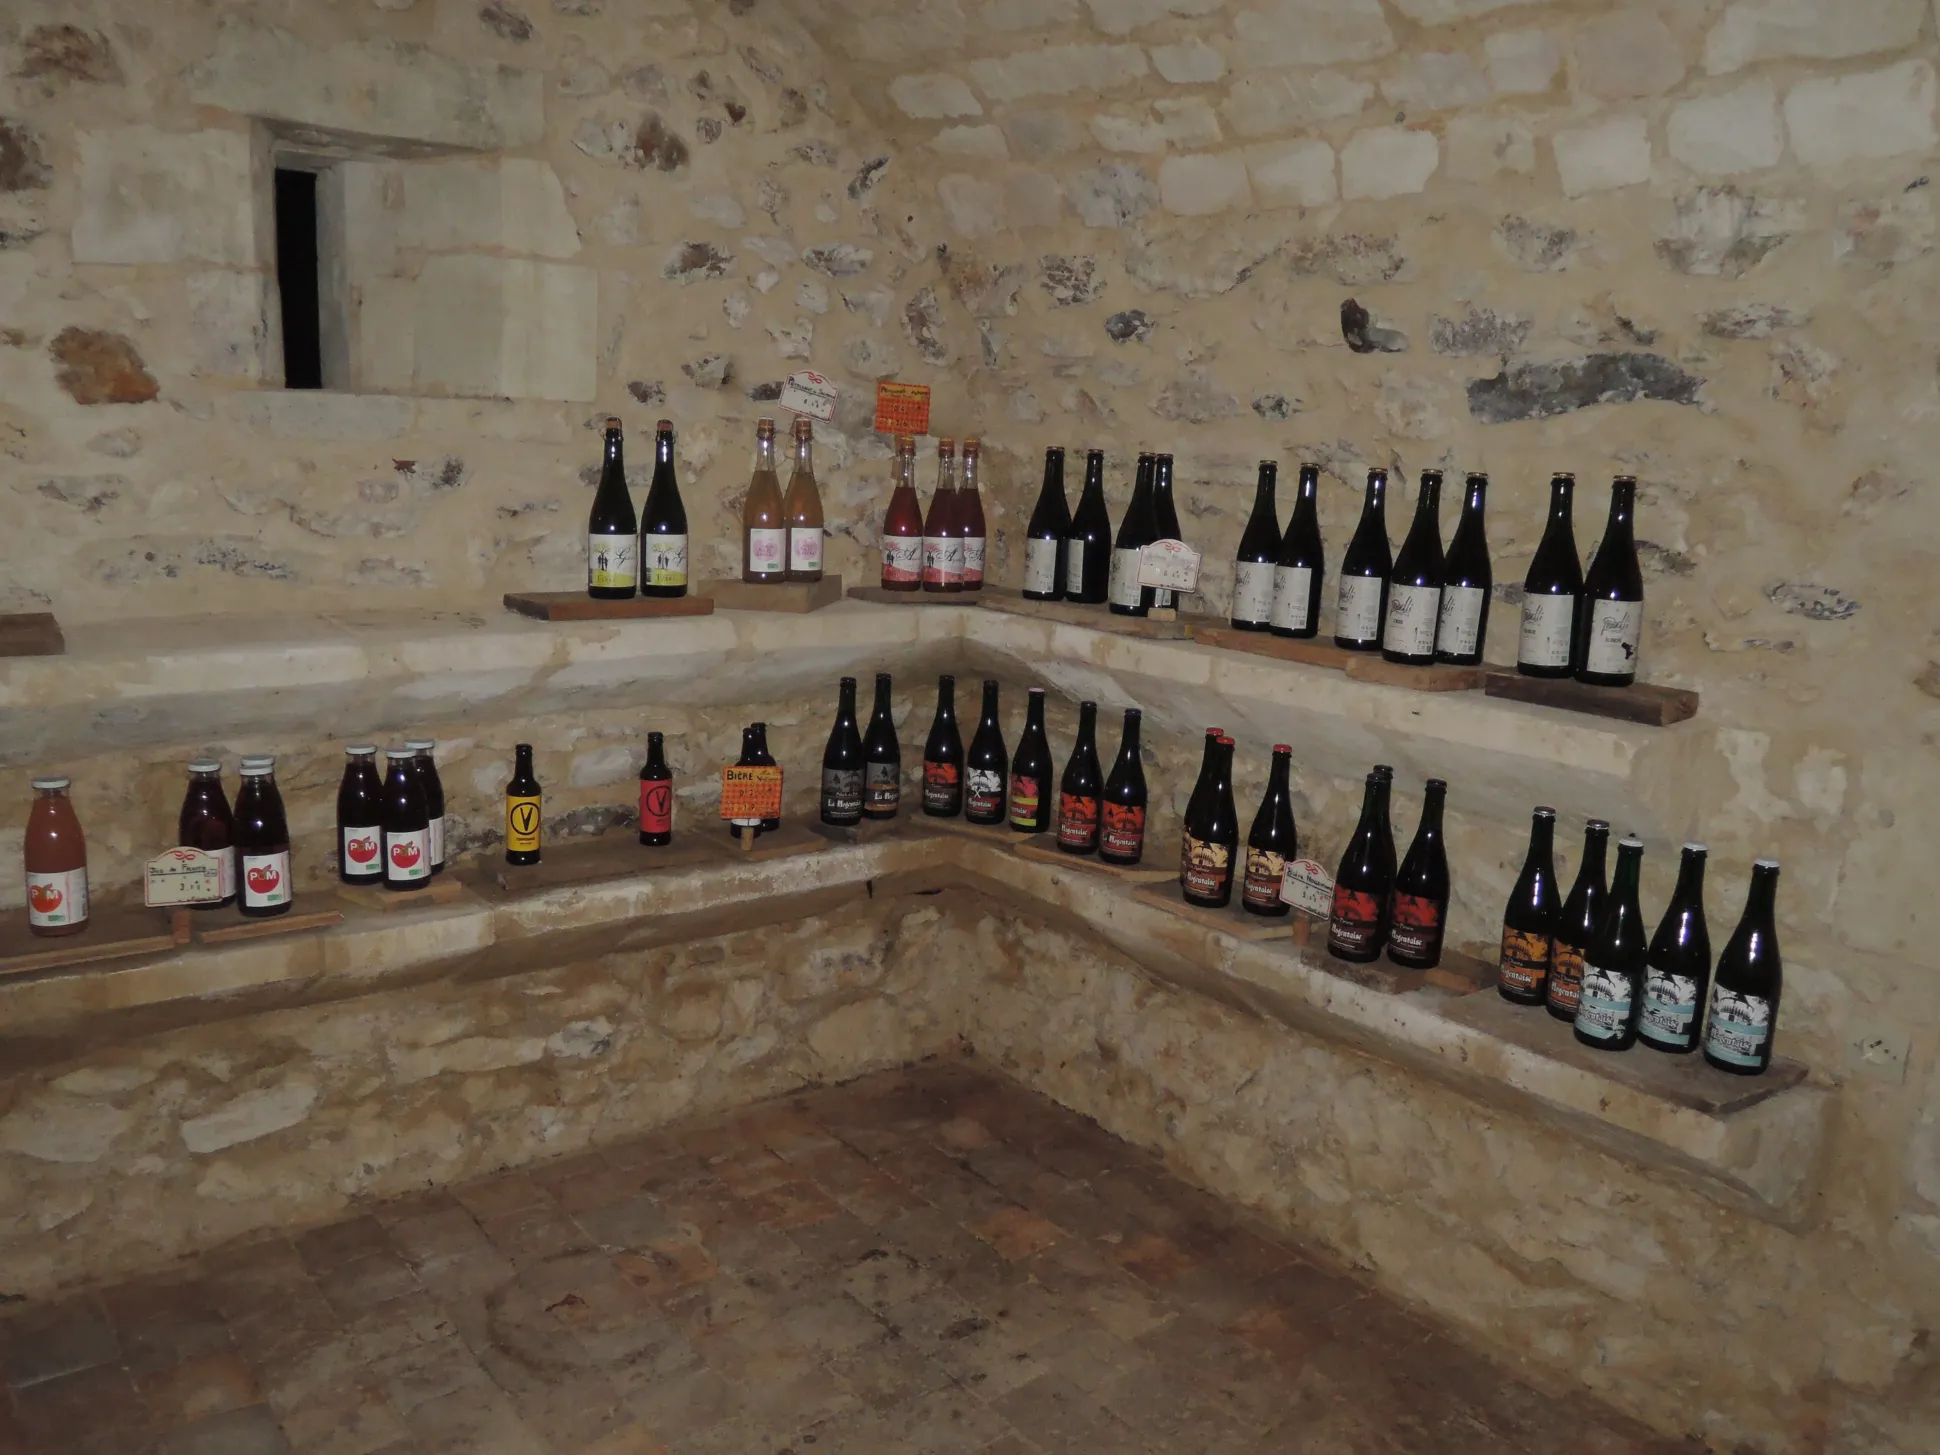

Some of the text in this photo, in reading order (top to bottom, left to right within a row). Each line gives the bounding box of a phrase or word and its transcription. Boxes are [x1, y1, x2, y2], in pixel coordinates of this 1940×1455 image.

[656, 790, 668, 813] V
[519, 806, 533, 832] V
[250, 871, 277, 882] POM
